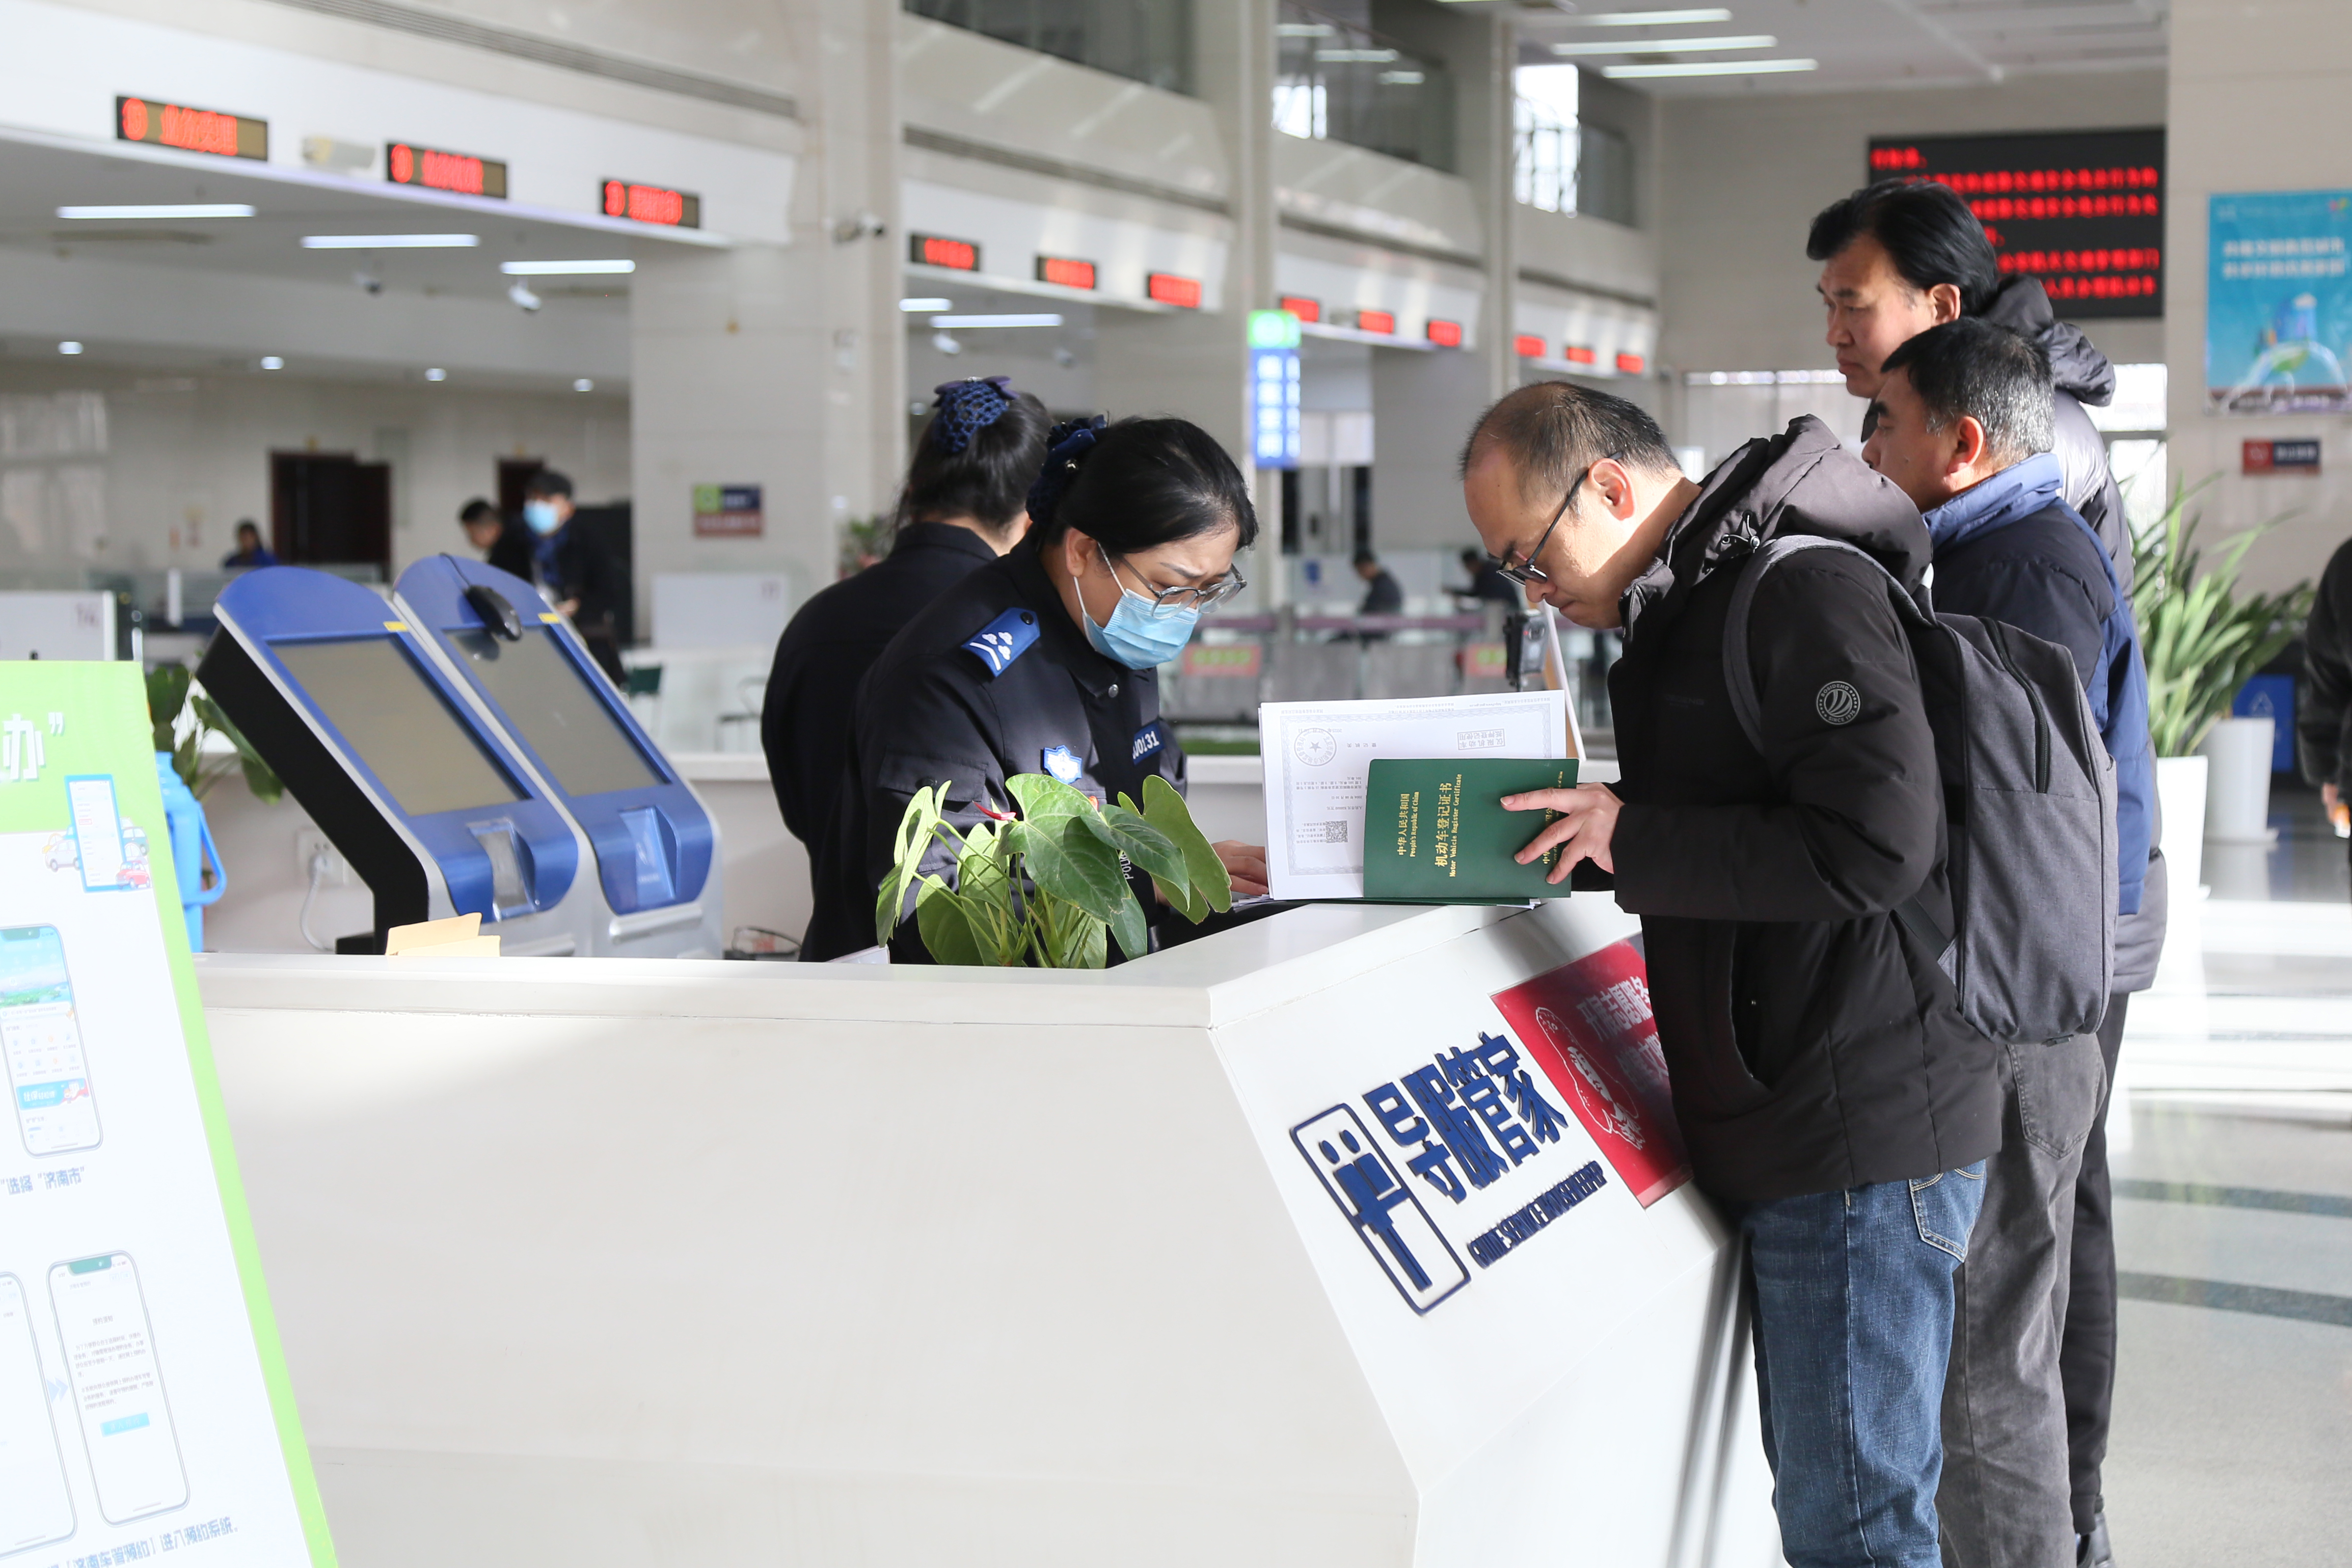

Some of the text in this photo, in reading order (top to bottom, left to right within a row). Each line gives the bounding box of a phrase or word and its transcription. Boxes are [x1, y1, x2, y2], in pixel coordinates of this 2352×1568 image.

[1821, 683, 1849, 698] BOSIDENG
[1845, 710, 1857, 721] 1976
[1460, 730, 1503, 741] 抵押登记使用
[1460, 738, 1503, 749] 仅限机动车
[1453, 774, 1462, 806] Certificate
[1397, 793, 1410, 855] 中华人民共和国
[1435, 783, 1452, 867] 机动车登记证书
[1362, 1031, 1568, 1205] 导服管家
[1467, 1160, 1608, 1269] GUIDE SERVICE HOUSEKEEPER
[92, 1315, 113, 1326] 预约须知
